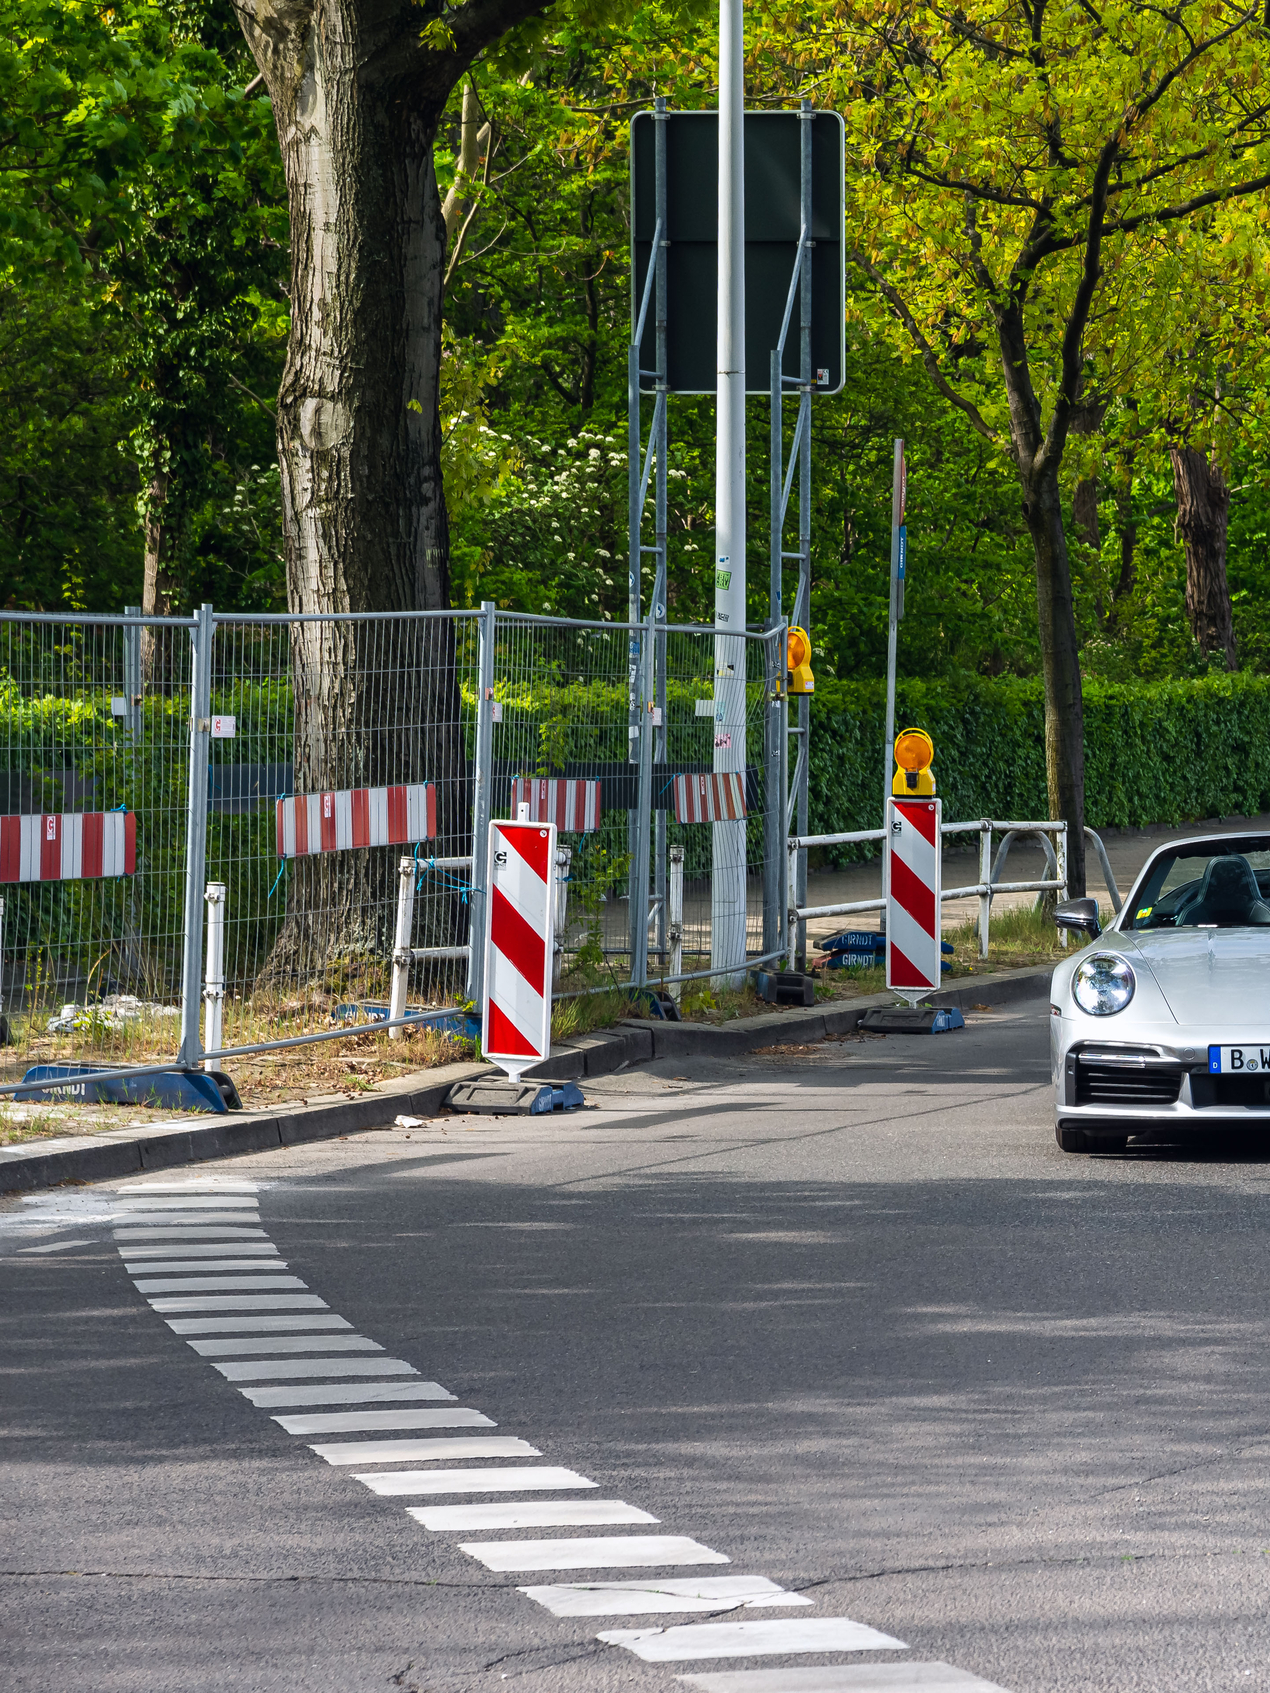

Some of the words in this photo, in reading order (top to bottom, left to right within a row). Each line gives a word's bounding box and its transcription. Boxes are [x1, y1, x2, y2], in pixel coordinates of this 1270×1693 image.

[841, 934, 873, 945] GIRNDT
[842, 954, 874, 967] GIRNDT
[1230, 1049, 1244, 1070] B
